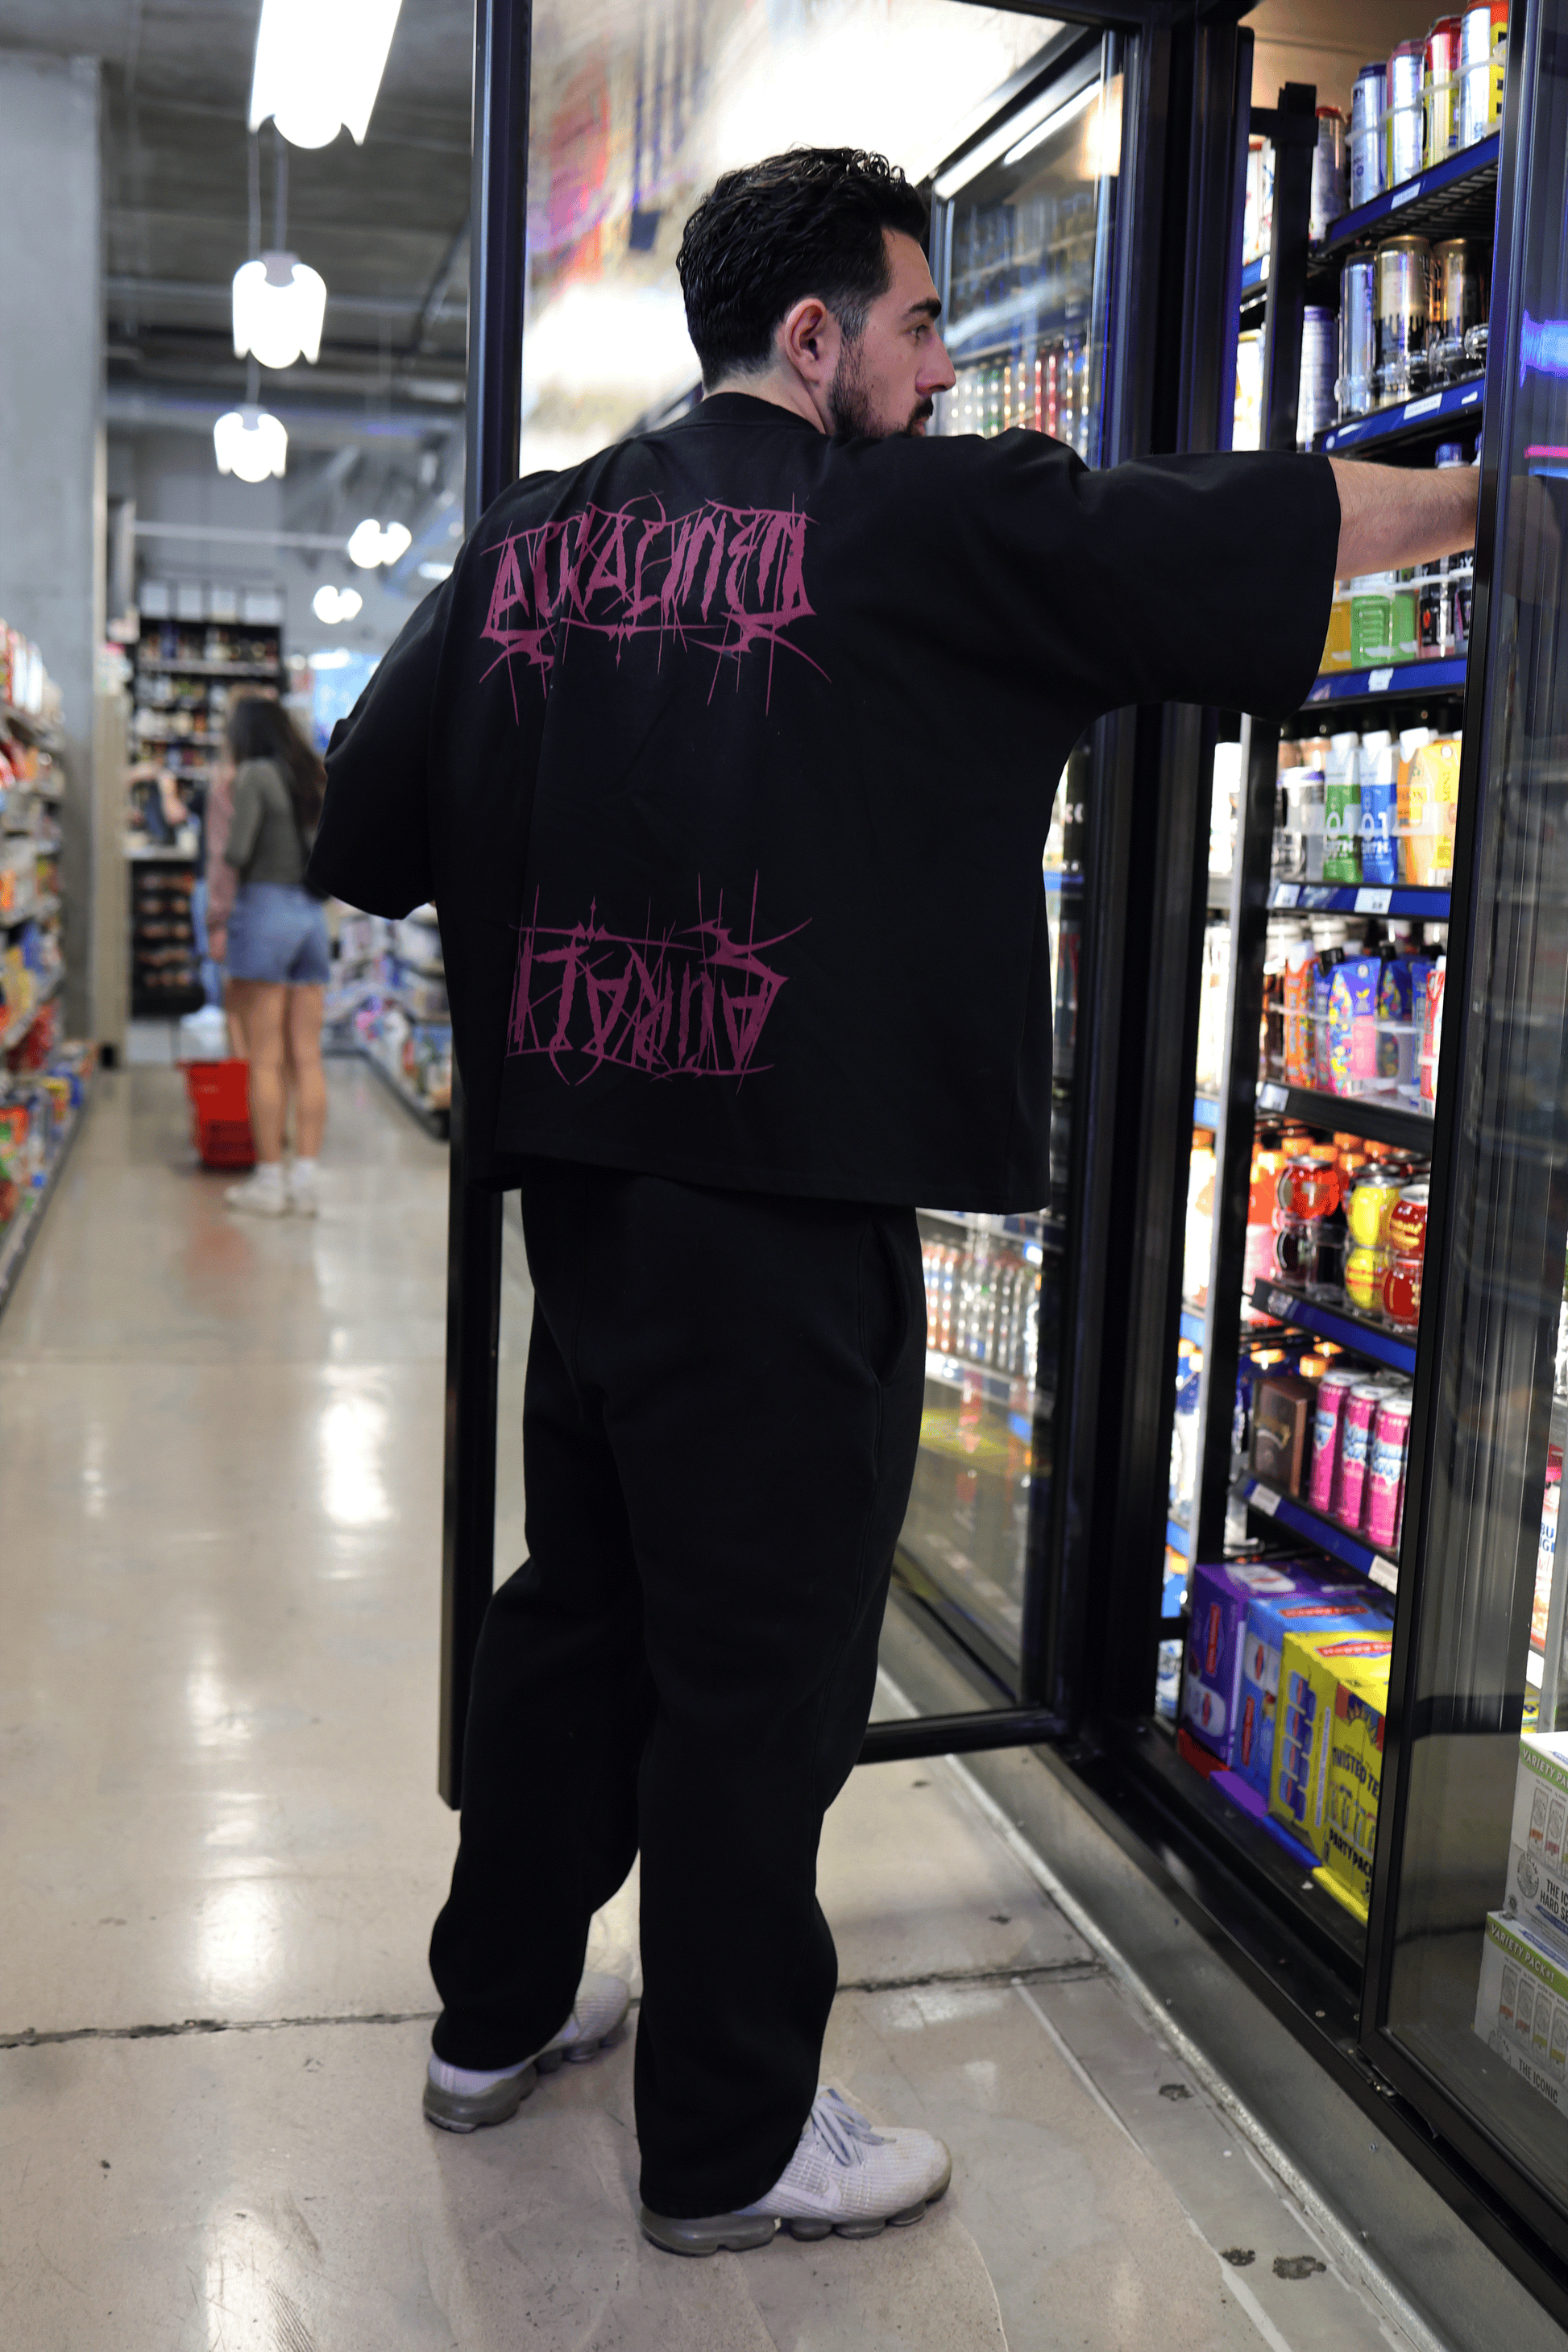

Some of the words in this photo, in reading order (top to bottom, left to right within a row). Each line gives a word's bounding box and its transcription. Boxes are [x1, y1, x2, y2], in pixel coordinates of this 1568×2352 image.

[1331, 1746, 1367, 1786] TWISTED
[1367, 1774, 1380, 1802] TE
[1523, 1748, 1556, 1778] VARIETY
[1540, 1889, 1559, 1914] HARD
[1560, 1905, 1568, 1924] SE
[1546, 1878, 1560, 1900] THE
[1491, 1923, 1524, 1958] VARIETY
[1524, 1951, 1546, 1977] PACK
[1518, 2057, 1532, 2080] THE
[1533, 2070, 1559, 2104] ICONIC
